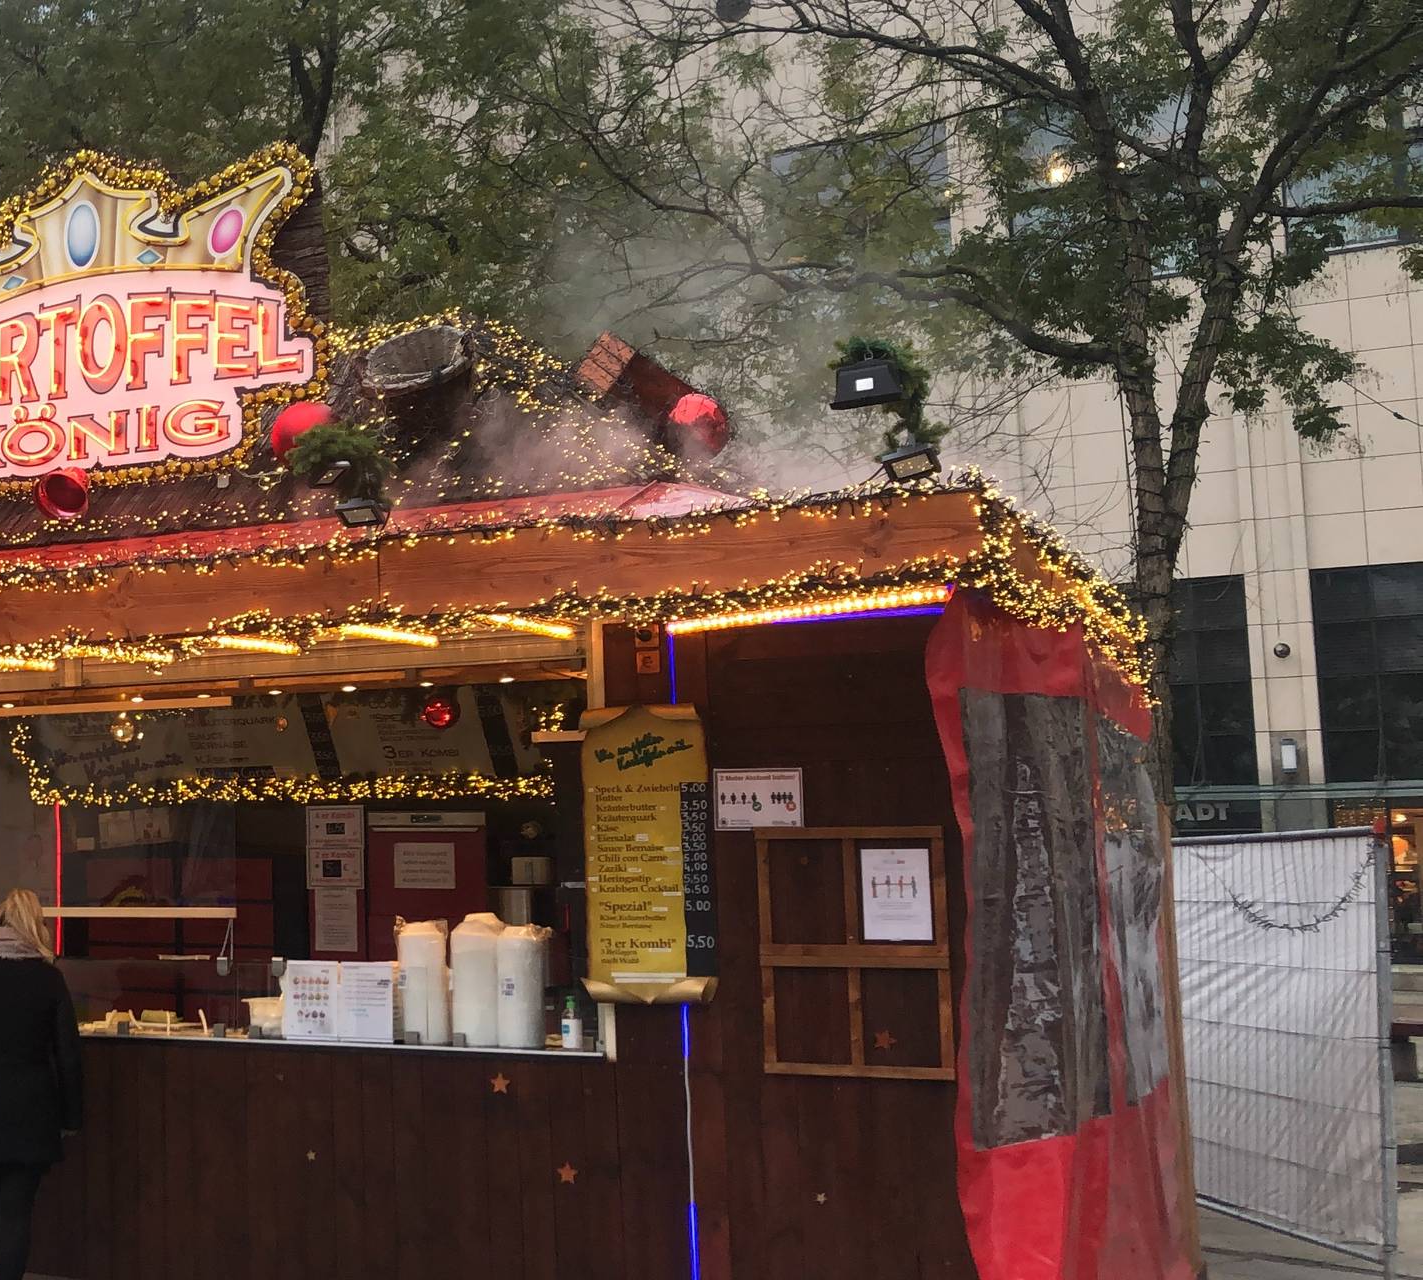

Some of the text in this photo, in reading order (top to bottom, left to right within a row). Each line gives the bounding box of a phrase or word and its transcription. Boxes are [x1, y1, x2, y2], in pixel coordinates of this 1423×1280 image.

[595, 784, 623, 795] Speck
[624, 784, 634, 793] &
[597, 824, 619, 832] Käse
[597, 844, 625, 852] Sauce
[597, 854, 622, 863] Chili
[640, 854, 668, 862] Carne
[598, 864, 627, 873] Zaziki
[598, 884, 679, 893] Krabben Cocktail
